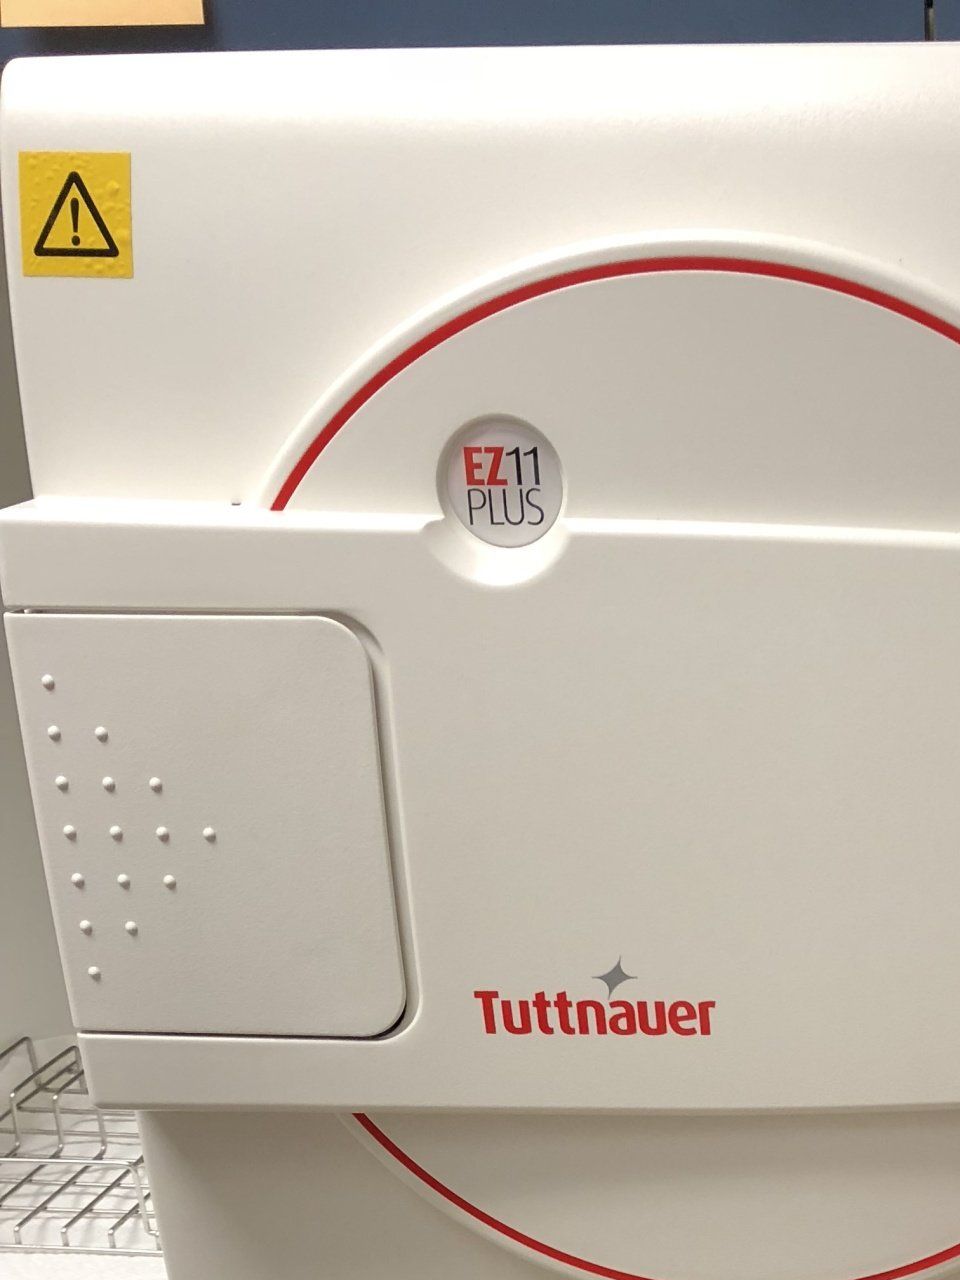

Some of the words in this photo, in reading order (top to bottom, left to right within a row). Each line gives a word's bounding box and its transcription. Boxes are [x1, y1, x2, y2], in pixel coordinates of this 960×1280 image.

[463, 446, 540, 486] EZ11
[467, 487, 545, 526] PLUS
[474, 990, 716, 1036] Tuttnauer
